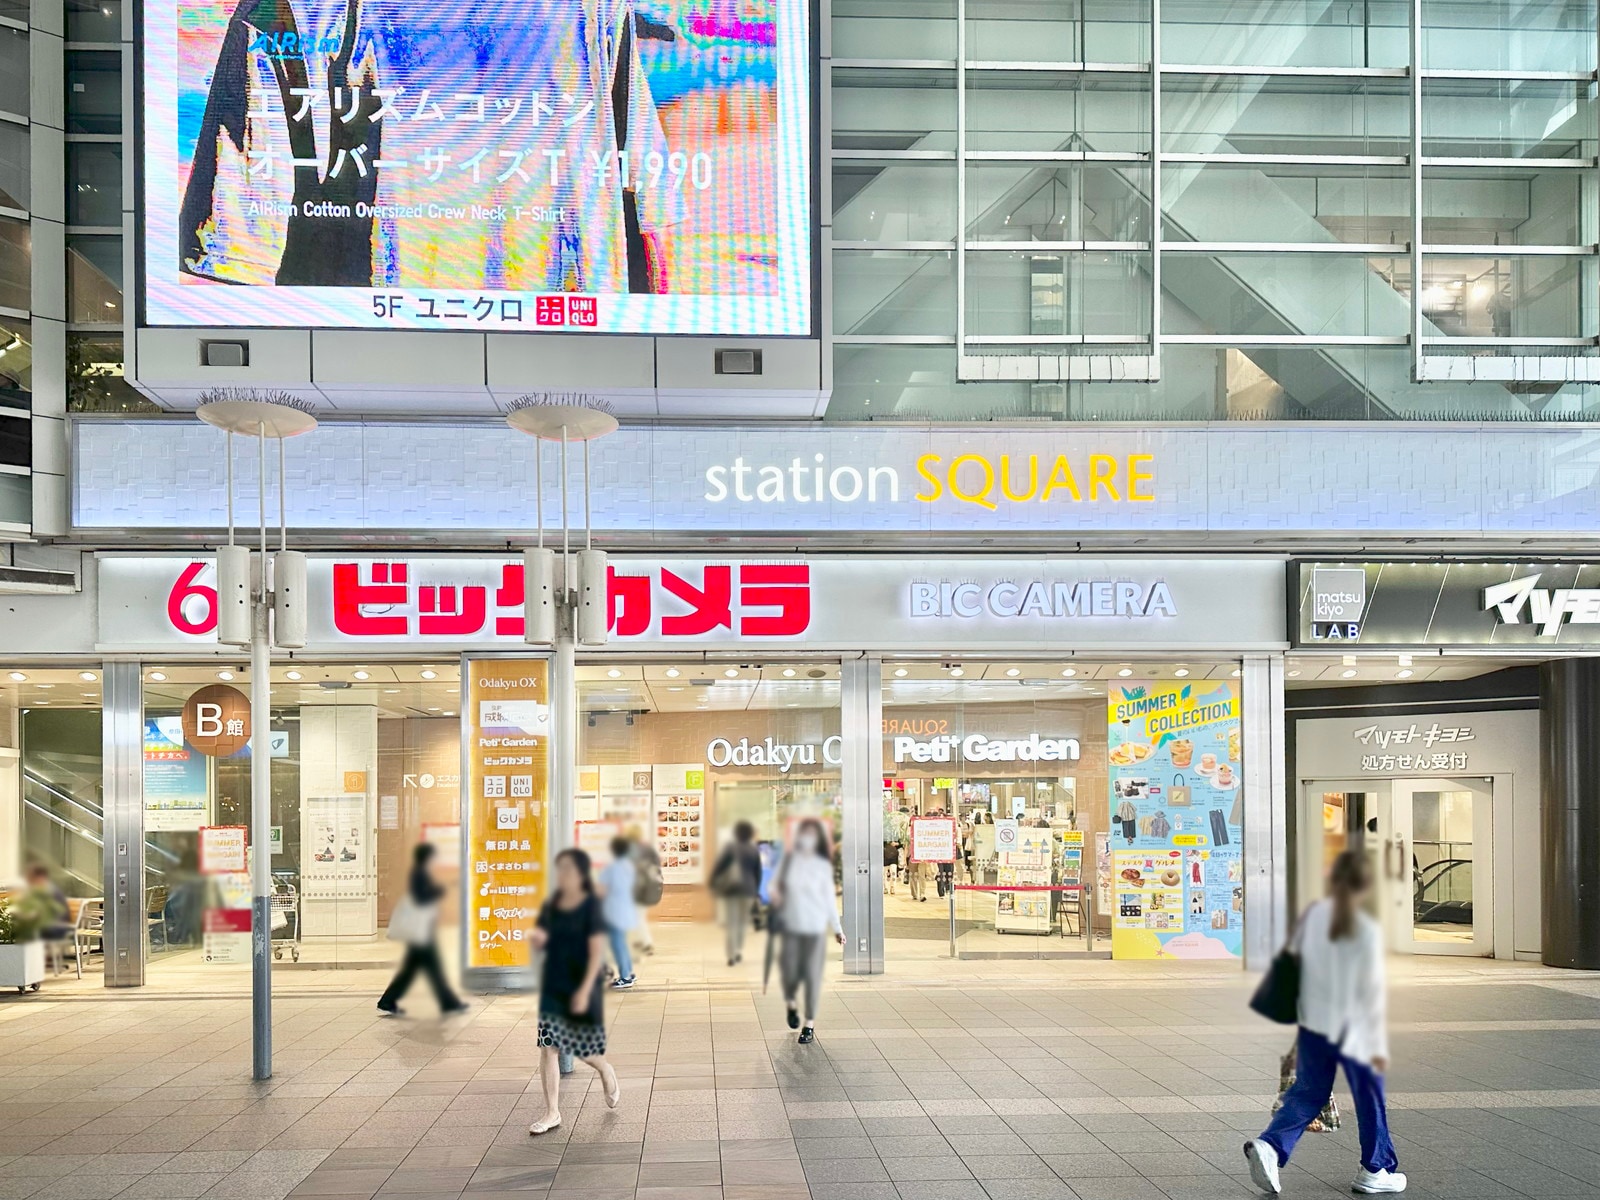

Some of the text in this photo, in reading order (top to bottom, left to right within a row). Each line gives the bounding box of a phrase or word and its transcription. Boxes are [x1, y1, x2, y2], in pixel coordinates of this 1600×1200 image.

[247, 31, 339, 55] AIRism
[247, 86, 595, 127] エアリズムコットン
[247, 144, 713, 194] オーバーサイズT ¥1,990
[249, 201, 566, 222] AIRism Cotton Oversized Crew Neck T-Shirt
[373, 295, 523, 322] 5F ユニクロ
[704, 453, 1156, 512] station SQUARE
[910, 581, 1179, 618] BIC CAMERA
[1317, 590, 1361, 604] matsu
[1317, 604, 1344, 620] kiyo
[1312, 624, 1360, 640] LAB
[479, 677, 537, 690] Odakyu OX
[1116, 692, 1178, 720] SUMMER
[1149, 701, 1232, 734] COLLECTION
[196, 703, 245, 737] B館
[501, 737, 538, 747] Garden
[962, 733, 1081, 763] Garden
[1353, 723, 1477, 750] マツモトキヨシ
[706, 737, 817, 773] Odakyu
[1361, 752, 1468, 771] 処方せん受付
[499, 813, 518, 824] GU
[488, 862, 541, 871] くまざわ
[479, 929, 530, 942] DAIS
